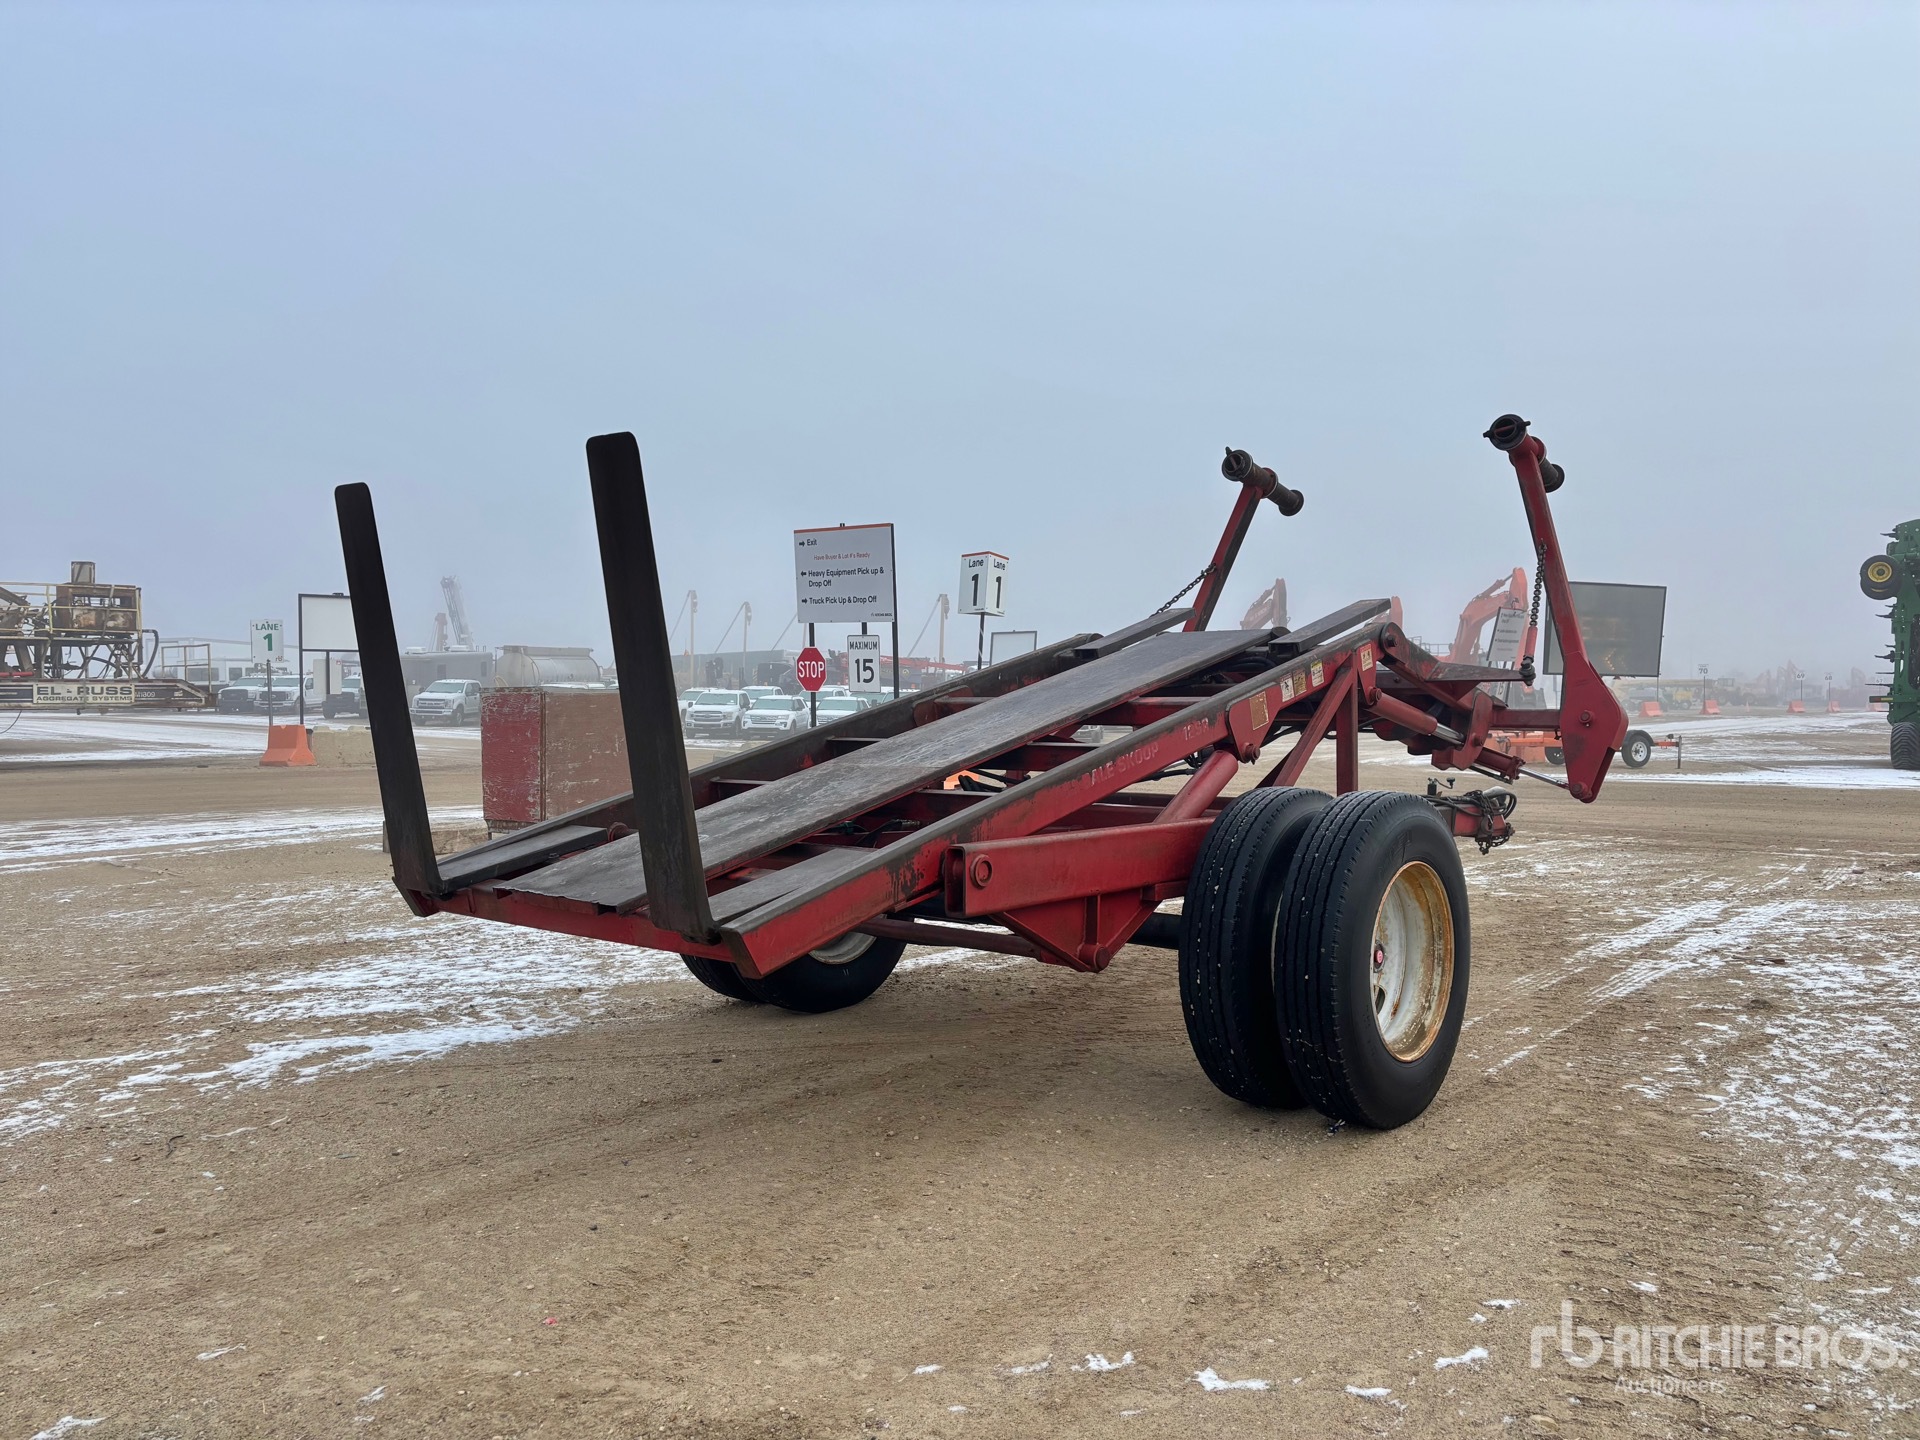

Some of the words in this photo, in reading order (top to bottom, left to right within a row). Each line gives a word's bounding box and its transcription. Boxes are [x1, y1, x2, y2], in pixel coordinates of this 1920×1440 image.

[969, 559, 984, 568] Lane
[994, 558, 1006, 570] Lane
[808, 570, 825, 578] Heavy
[826, 568, 856, 577] Equipment
[972, 574, 979, 606] 1
[996, 576, 1002, 608] 1
[839, 597, 847, 605] Up
[853, 596, 867, 604] Drop
[263, 633, 273, 651] 1
[849, 641, 877, 650] MAXIMUM
[798, 661, 824, 678] STOP
[855, 658, 874, 683] 15
